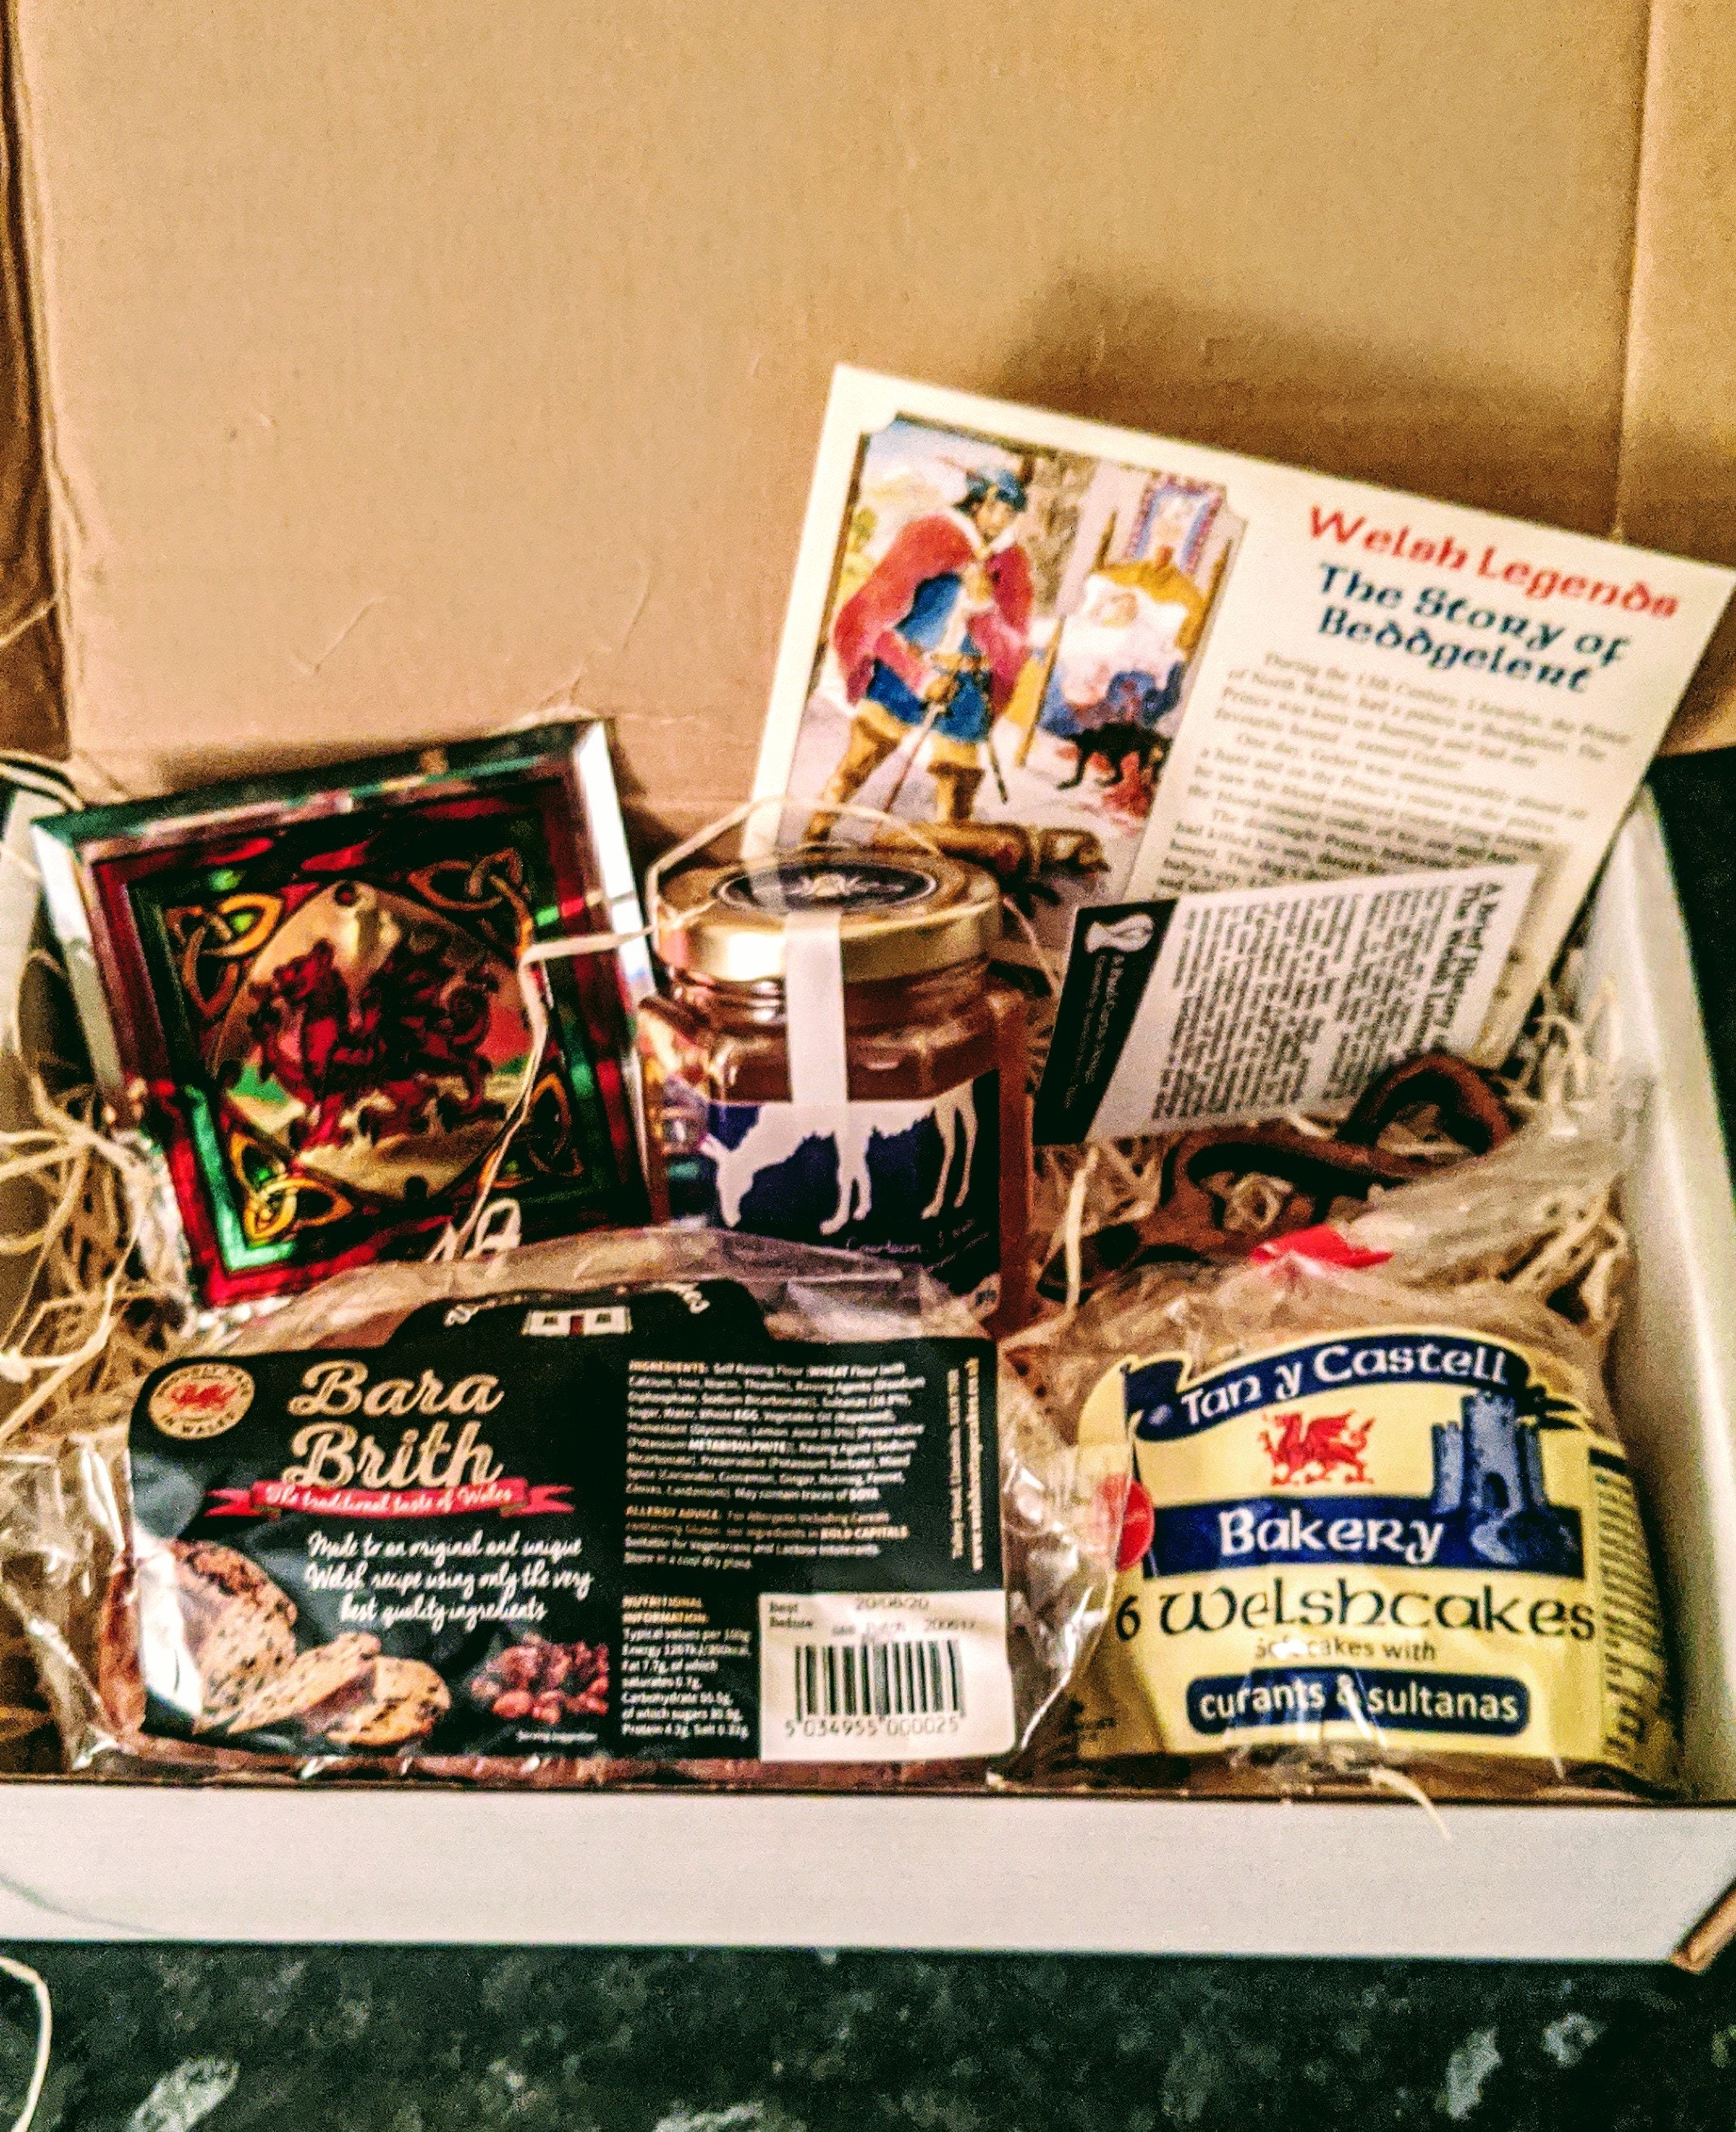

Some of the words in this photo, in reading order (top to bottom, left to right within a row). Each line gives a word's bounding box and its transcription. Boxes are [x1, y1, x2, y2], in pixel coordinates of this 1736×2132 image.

[1309, 505, 1469, 573] Welsh
[1477, 544, 1680, 620] Legends
[1319, 563, 1403, 611] The
[1419, 586, 1565, 651] Story
[1575, 631, 1631, 666] of
[289, 1359, 506, 1417] Bara
[1181, 1374, 1261, 1426] Tan
[1275, 1363, 1302, 1400] y
[1314, 1345, 1507, 1385] Castell
[281, 1420, 506, 1490] Brith
[307, 1530, 360, 1558] Made
[362, 1532, 383, 1557] to
[383, 1540, 405, 1556] an
[408, 1529, 484, 1568] original
[485, 1529, 521, 1556] and
[1218, 1508, 1443, 1564] Bakery
[305, 1561, 368, 1589] Welsh
[478, 1562, 517, 1601] only
[522, 1559, 551, 1588] the
[552, 1572, 594, 1601] very
[340, 1592, 379, 1622] best
[381, 1593, 447, 1634] quality
[447, 1594, 548, 1632] ingredients
[1116, 1595, 1141, 1640] 6
[1160, 1577, 1594, 1641] Welshcakes
[1382, 1639, 1437, 1660] with
[1367, 1679, 1520, 1723] sultanas
